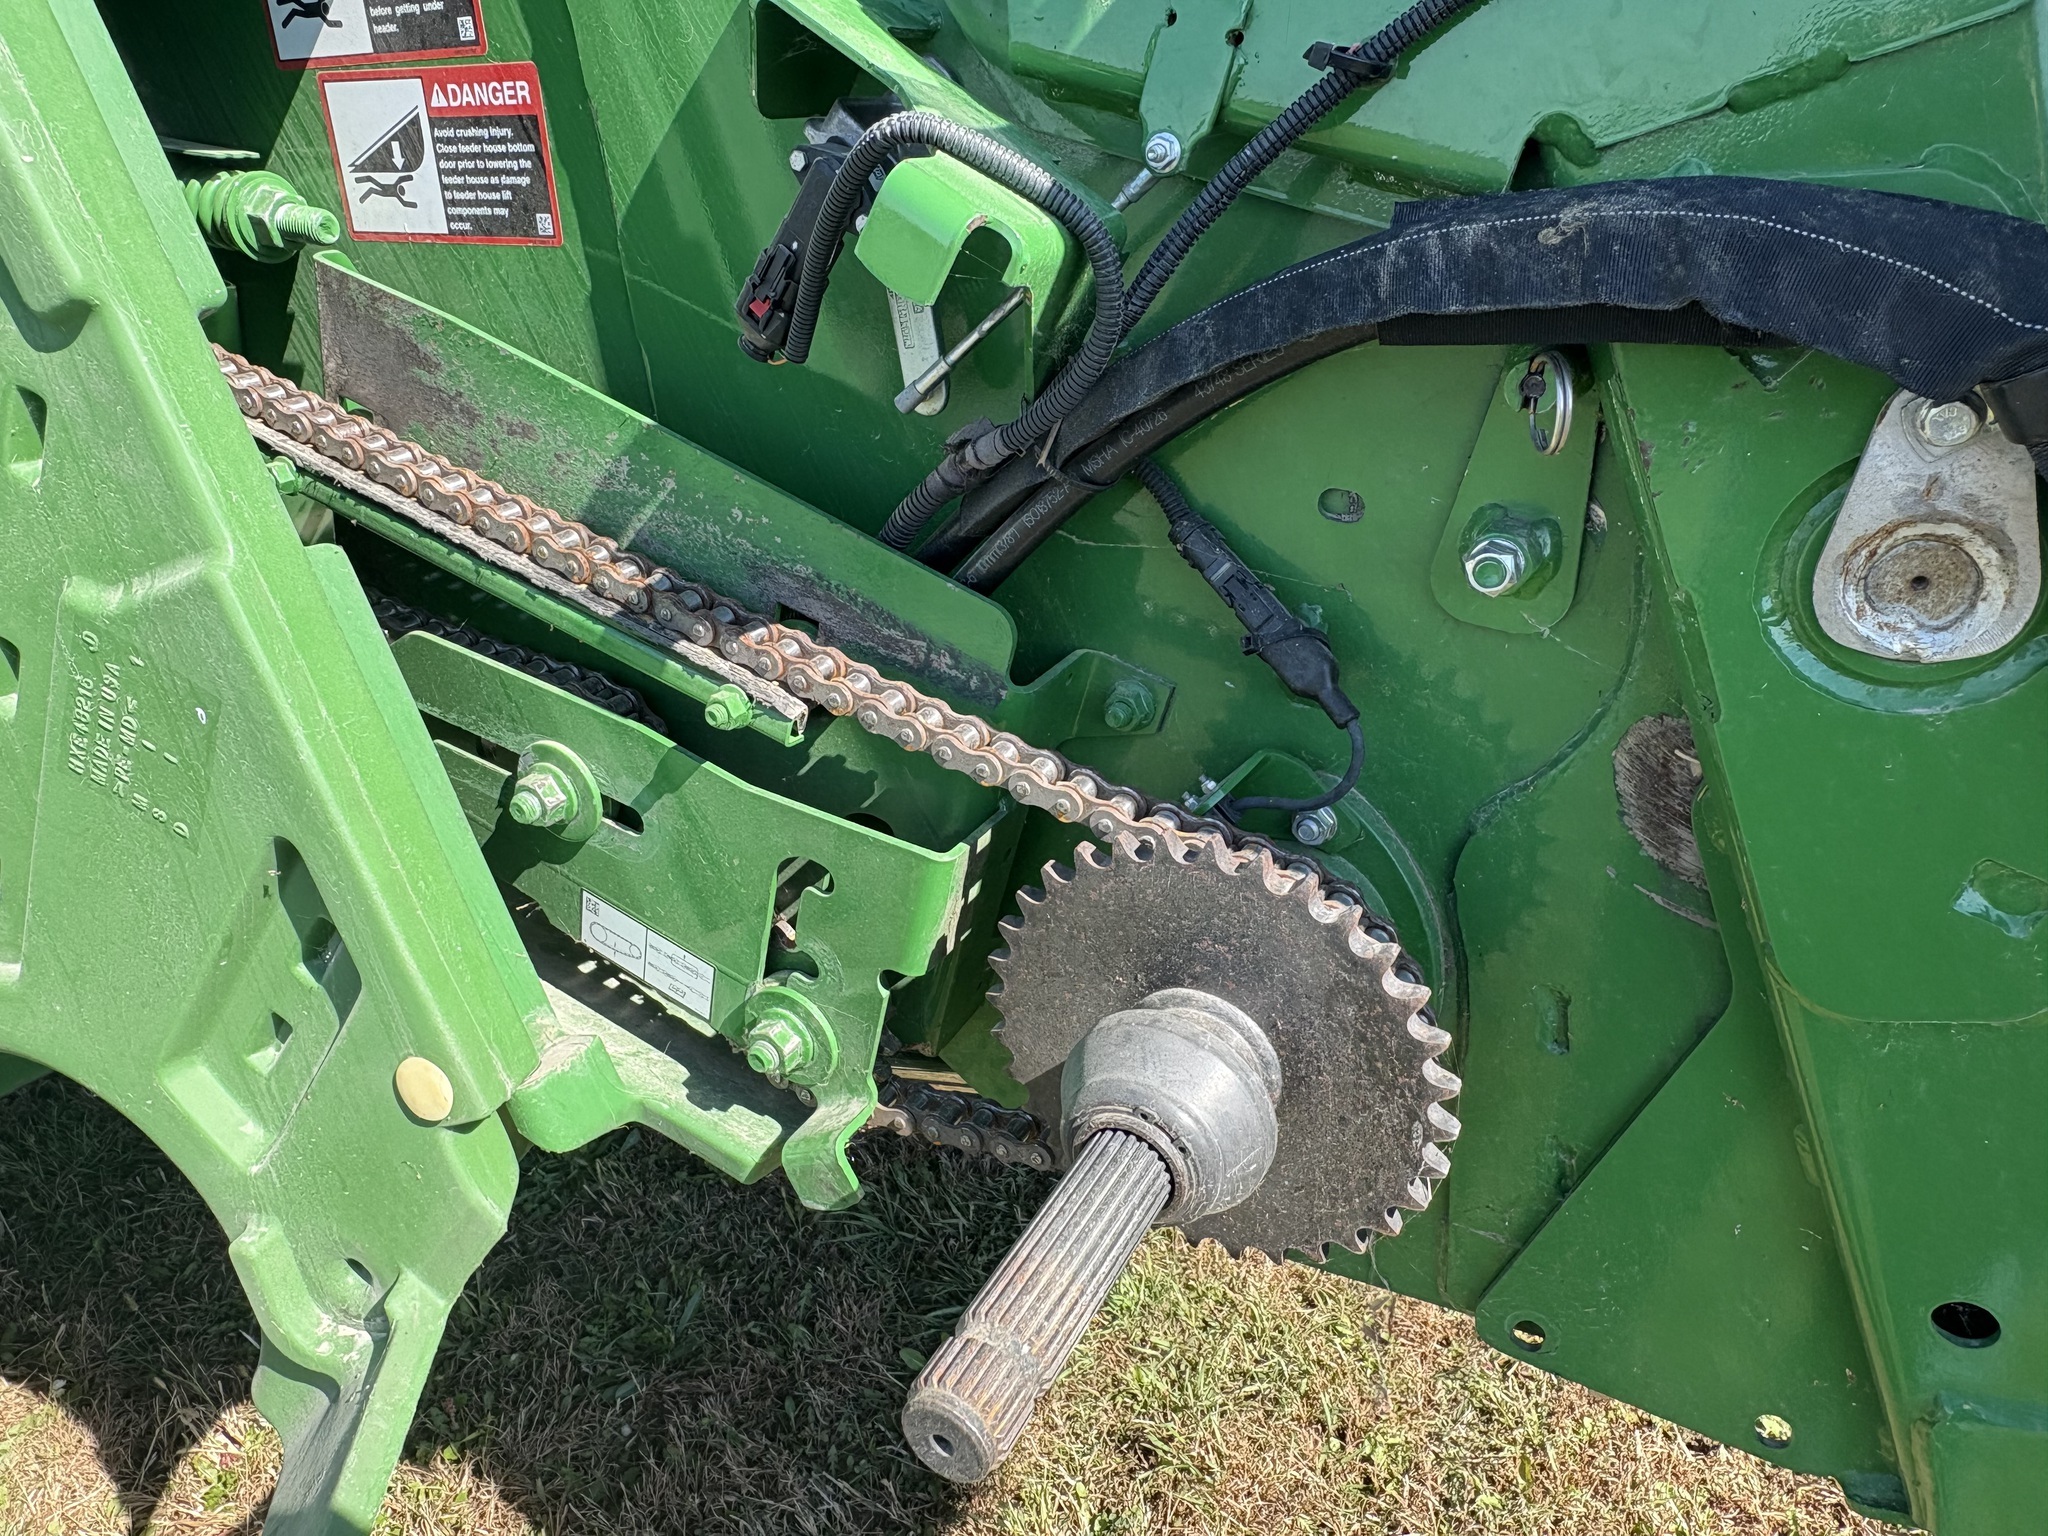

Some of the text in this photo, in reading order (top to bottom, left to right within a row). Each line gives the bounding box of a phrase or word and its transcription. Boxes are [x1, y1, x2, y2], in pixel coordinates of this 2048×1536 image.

[369, 0, 445, 17] before getting under
[372, 22, 400, 34] header.
[446, 80, 532, 107] DANGER
[433, 126, 514, 139] Avoid crushing injury.
[436, 142, 536, 153] Close feeder house bottom
[439, 158, 532, 171] door prior to lowering the
[441, 174, 531, 187] feeder house as damage
[444, 190, 513, 200] to feeder house lift
[447, 206, 509, 218] components may
[449, 222, 473, 231] occur.
[1080, 444, 1119, 477] MSHA
[90, 662, 121, 787] MADE IN USA
